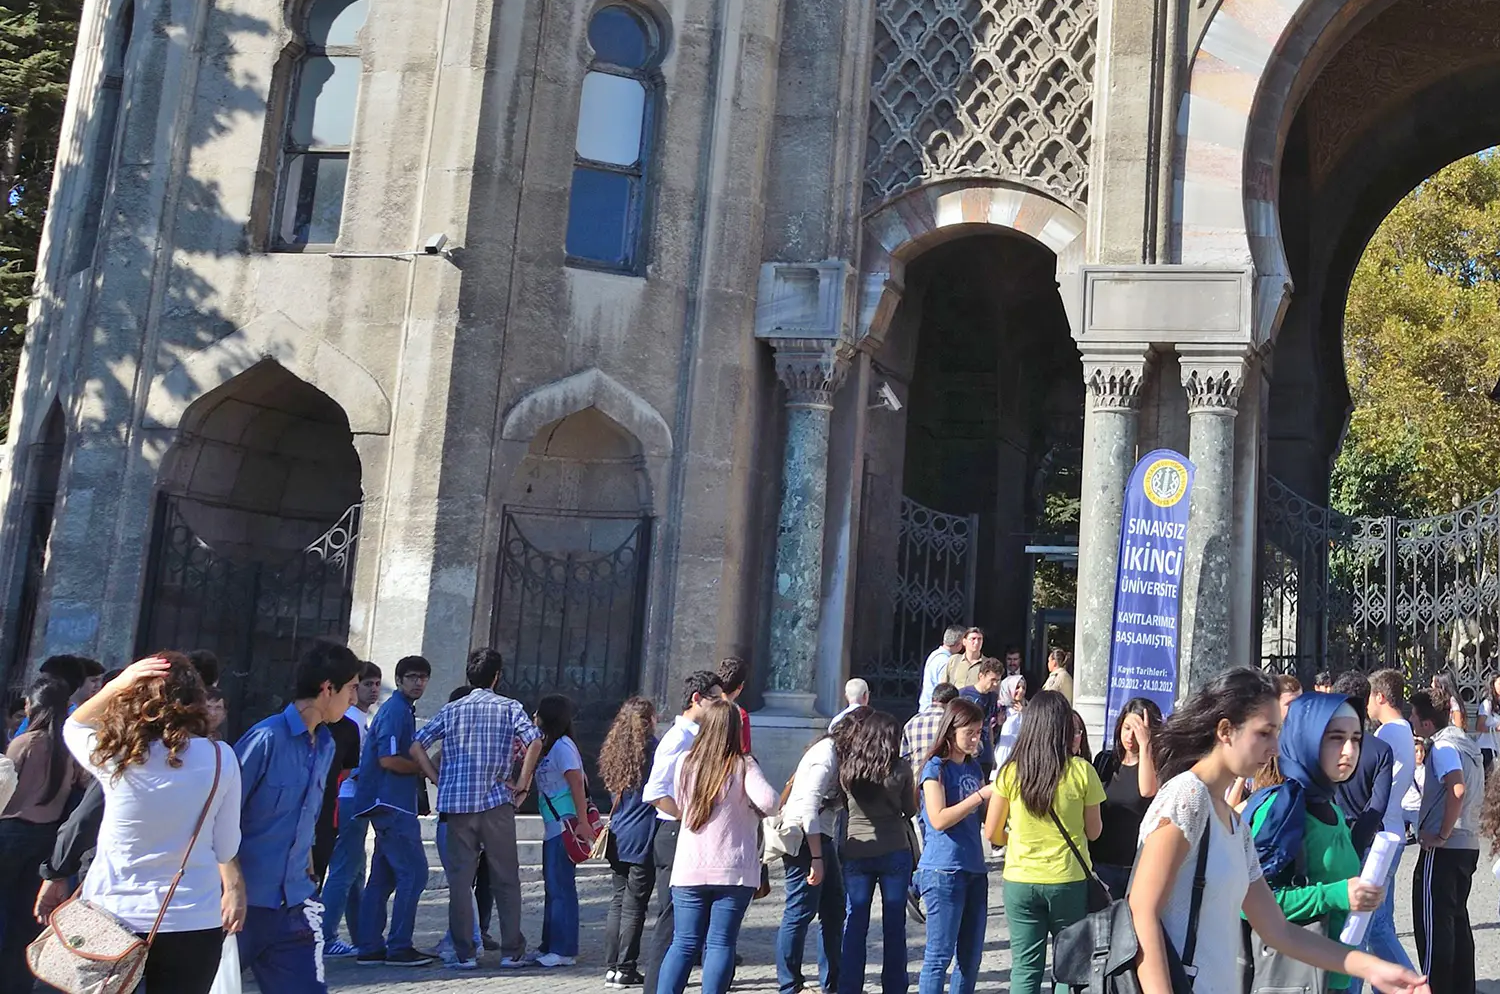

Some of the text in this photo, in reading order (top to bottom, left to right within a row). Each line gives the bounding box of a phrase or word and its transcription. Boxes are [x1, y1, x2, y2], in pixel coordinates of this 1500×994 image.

[1128, 518, 1186, 540] SINAVSIZ
[1123, 539, 1183, 575] İKİNCİ
[1121, 575, 1178, 599] ÜNİVERSİTE
[1117, 611, 1175, 629] KAYITLARIMIZ
[1115, 631, 1175, 648] BAŞLAMIŞTIR.
